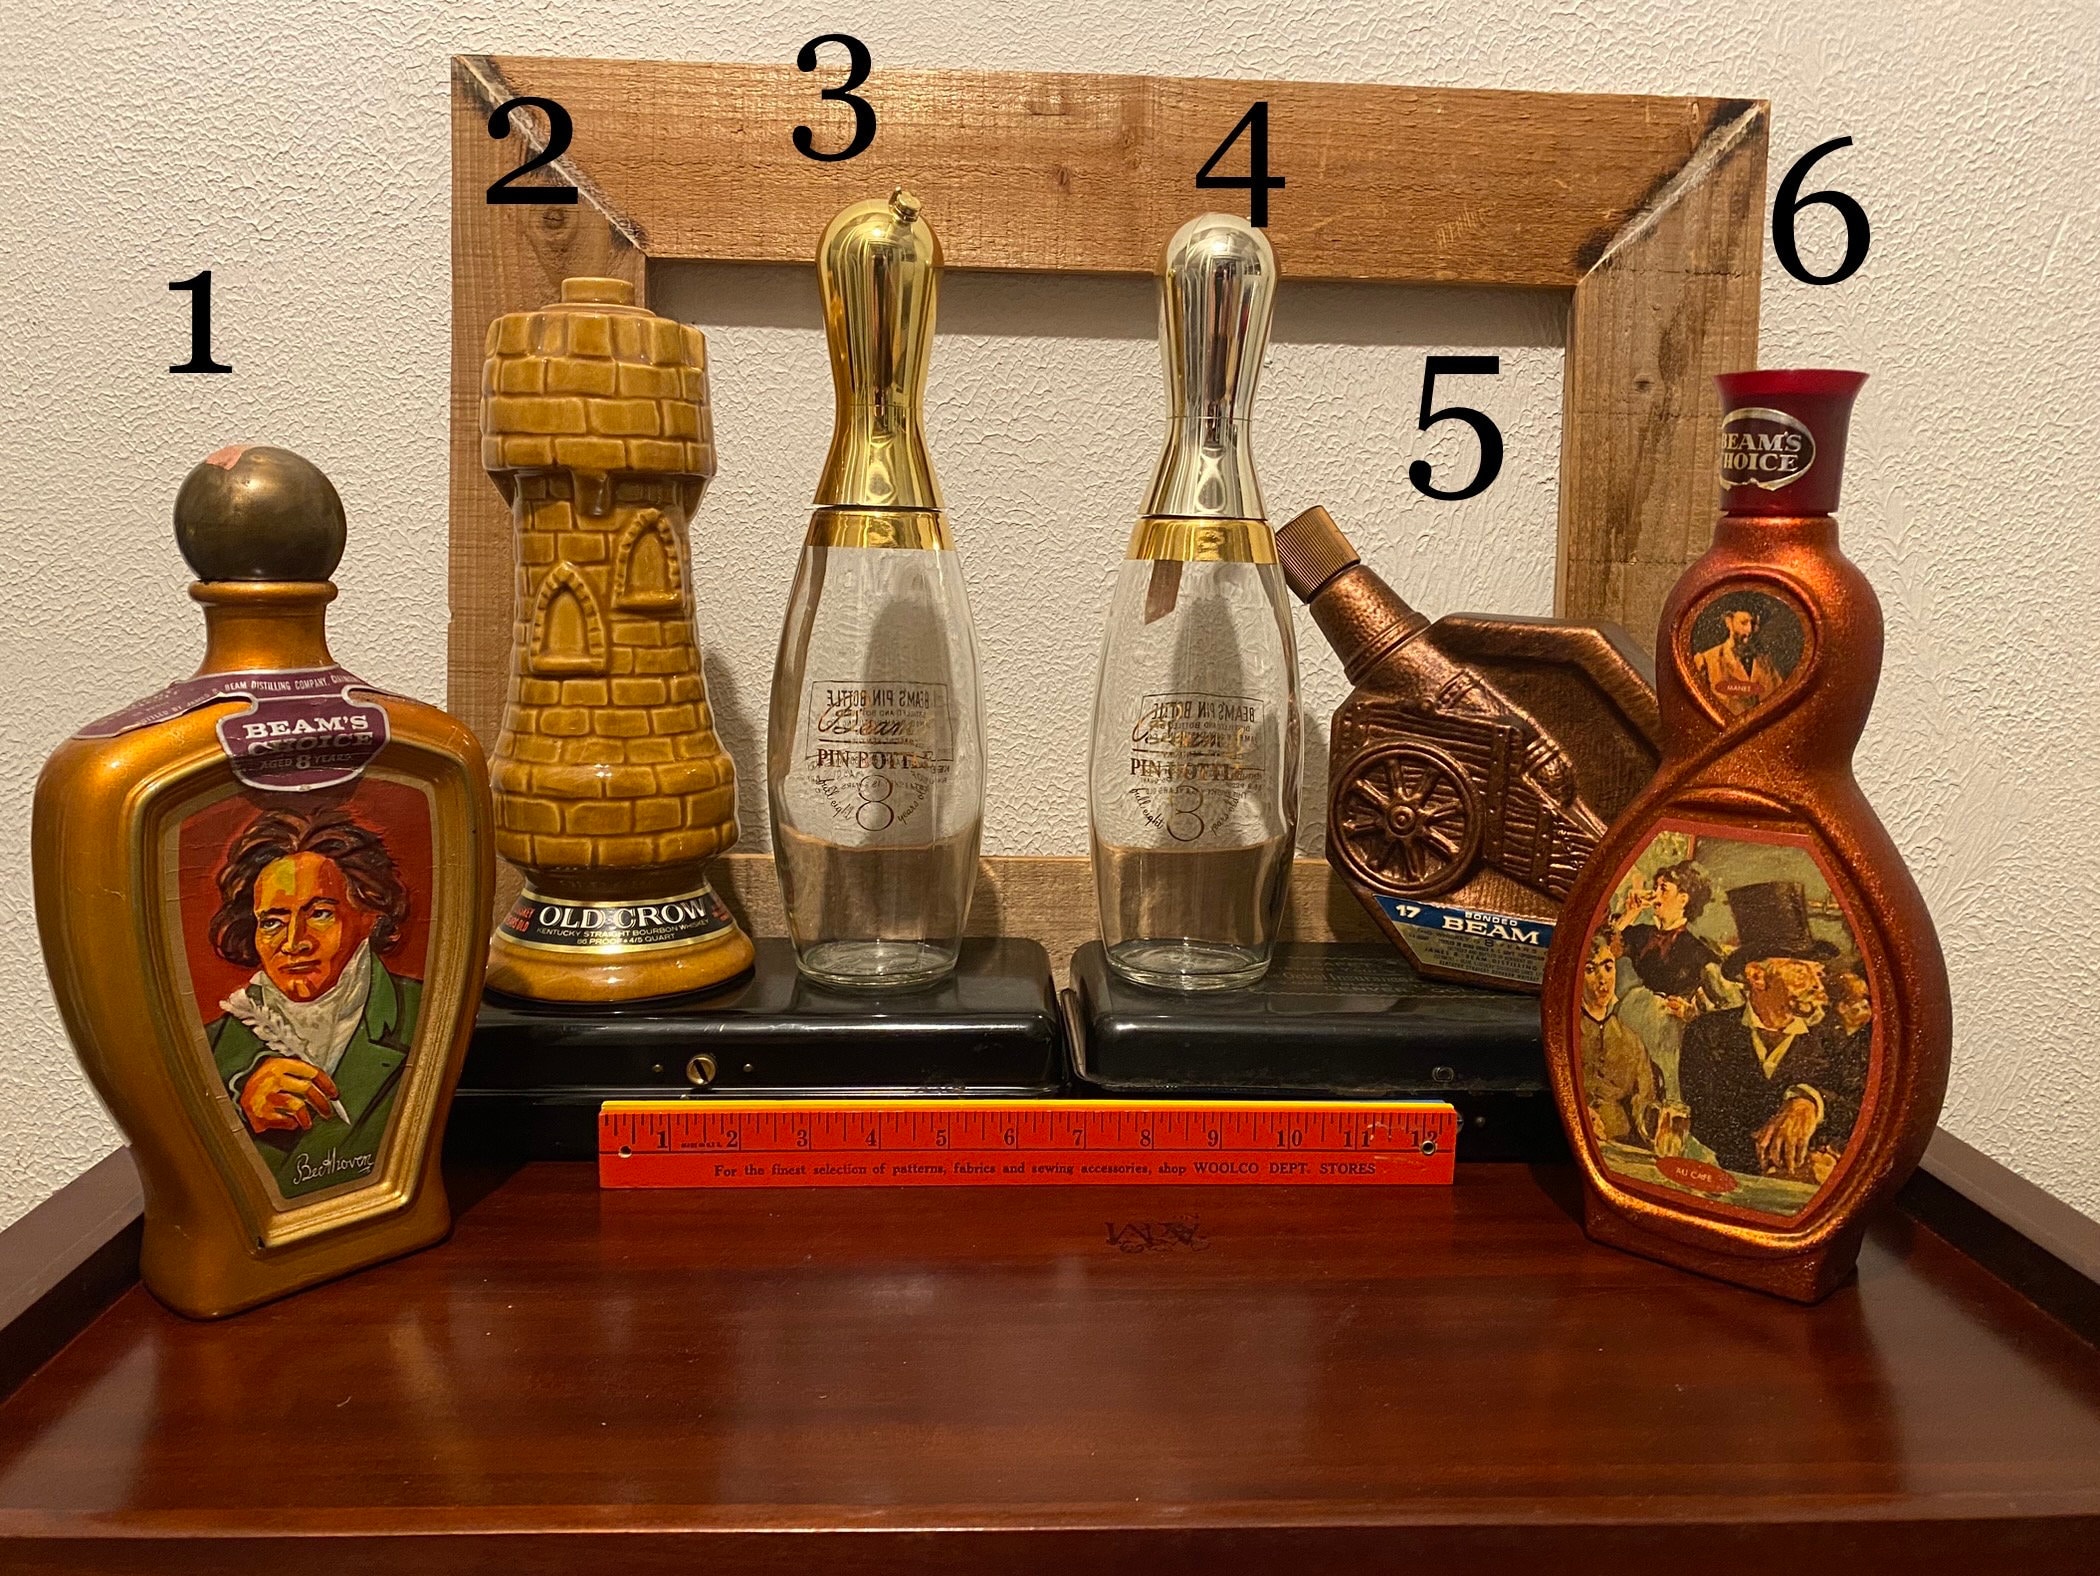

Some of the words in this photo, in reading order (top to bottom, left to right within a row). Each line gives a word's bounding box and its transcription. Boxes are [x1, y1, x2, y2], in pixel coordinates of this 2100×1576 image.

[1721, 431, 1802, 452] BEAM'S
[1722, 452, 1798, 471] HOICE
[225, 681, 247, 692] BEAM
[251, 680, 291, 692] DISTILLING
[242, 715, 369, 739] BEAM'S
[247, 732, 374, 756] CHOICE
[260, 758, 293, 769] AGED
[296, 755, 311, 769] 8
[315, 753, 351, 764] YEARS
[816, 748, 852, 770] PIN
[1130, 757, 1161, 778] PIN
[855, 774, 895, 832] 8
[539, 905, 606, 929] OLD
[613, 897, 706, 929] CROW
[1395, 904, 1421, 918] 17
[1464, 911, 1518, 927] BONDED
[536, 927, 581, 937] KENTUCKY
[583, 929, 630, 937] STRAIGHT
[632, 925, 679, 936] BOURBON
[678, 918, 709, 930] WHISKEY
[1441, 915, 1540, 945] BEAM
[644, 933, 676, 943] QUART
[1484, 938, 1495, 947] 8
[1465, 953, 1488, 961] BEAM
[1491, 958, 1538, 971] DISTILLING
[656, 1131, 668, 1149] 1
[726, 1129, 738, 1148] 2
[796, 1129, 808, 1147] 3
[865, 1129, 877, 1146] 4
[935, 1129, 947, 1146] 5
[1004, 1128, 1016, 1145] 6
[1072, 1129, 1083, 1146] 7
[1140, 1129, 1151, 1146] 8
[1207, 1129, 1218, 1146] 9
[1277, 1129, 1303, 1147] 10
[714, 1165, 737, 1177] For
[744, 1165, 764, 1175] the
[771, 1164, 806, 1175] finest
[813, 1164, 867, 1174] selection
[872, 1163, 886, 1174] of
[892, 1163, 947, 1176] patterns,
[953, 1163, 996, 1174] fabrics
[1003, 1162, 1025, 1174] and
[1031, 1163, 1074, 1176] sewing
[1081, 1163, 1152, 1175] accessories,
[1158, 1163, 1186, 1176] shop
[1193, 1162, 1259, 1174] WOOLCO
[1269, 1162, 1312, 1174] DEPT.
[1319, 1162, 1376, 1175] STORES
[1676, 1166, 1688, 1177] AU
